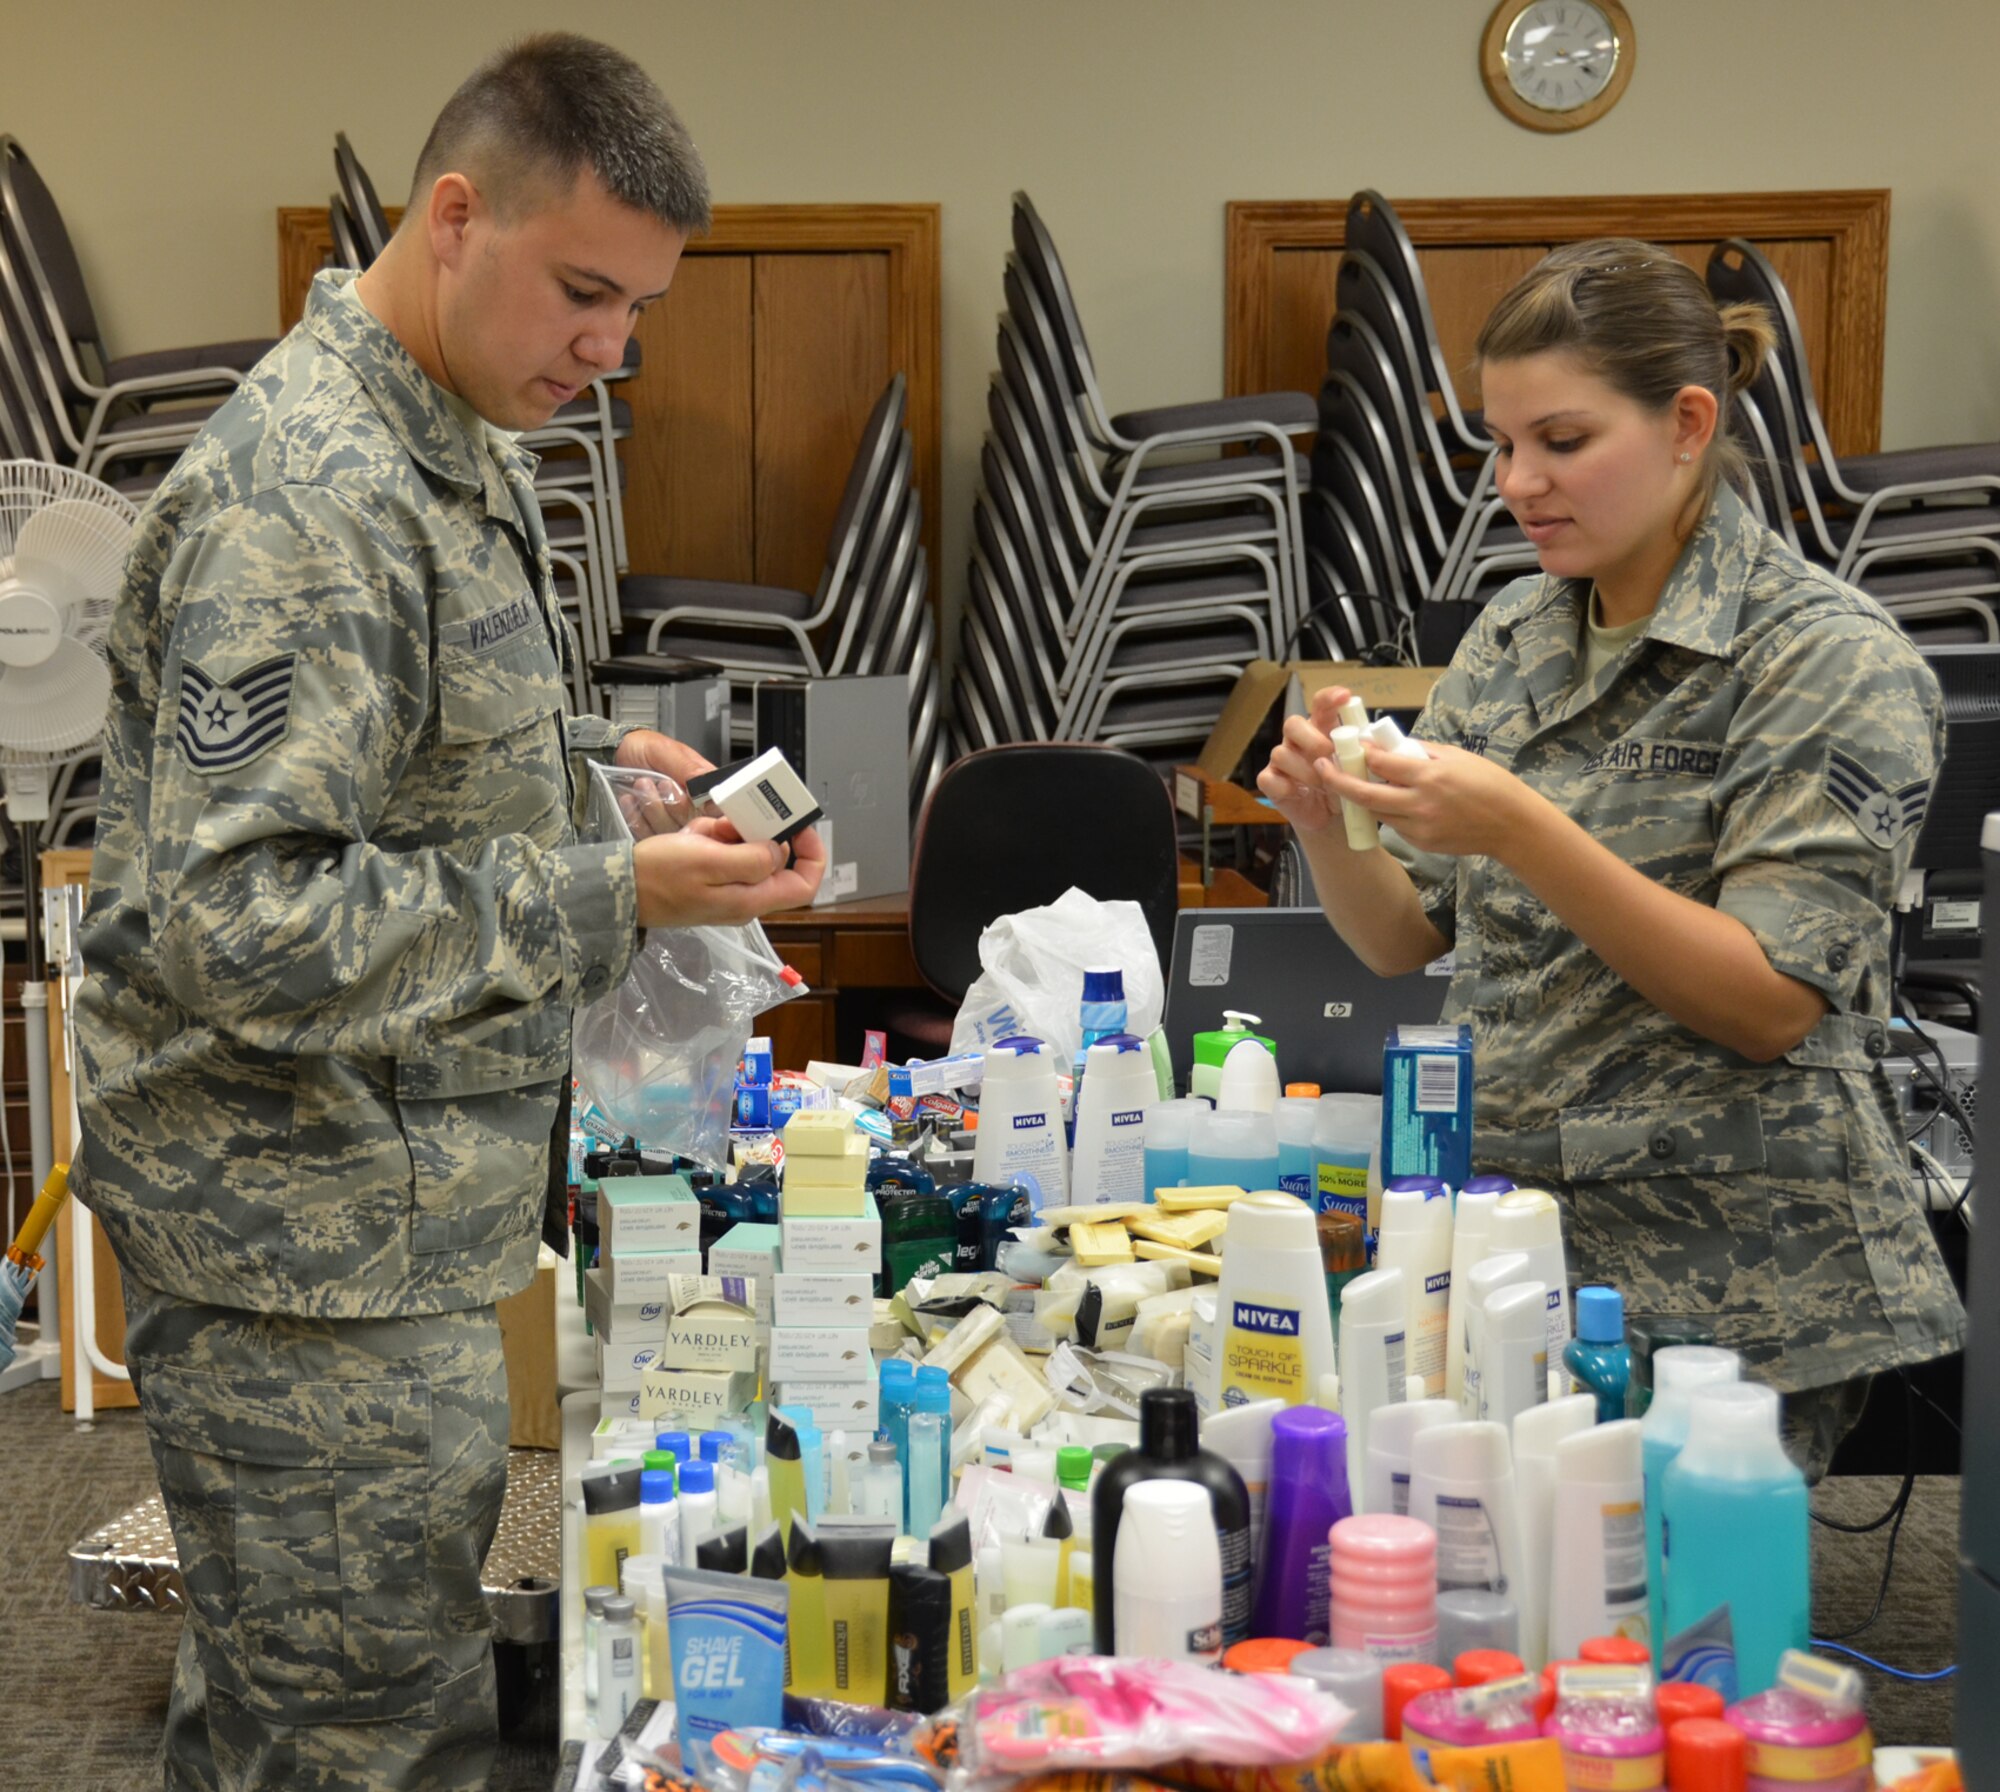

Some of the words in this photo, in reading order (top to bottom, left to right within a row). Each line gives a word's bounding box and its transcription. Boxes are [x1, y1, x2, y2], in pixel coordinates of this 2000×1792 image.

[470, 599, 532, 650] VALENZUELA
[1607, 743, 1642, 768] AIR
[1652, 744, 1722, 776] FORCE
[921, 1096, 958, 1113] Colgate
[1014, 1115, 1045, 1128] NIVEA
[1113, 1112, 1142, 1125] NIVEA
[585, 1119, 621, 1145] Aquafresh
[1280, 1176, 1312, 1194] Suave
[1319, 1174, 1337, 1186] 50%
[1338, 1177, 1368, 1189] MORE
[875, 1188, 917, 1197] PROTECTED
[1320, 1195, 1365, 1217] Suave
[914, 1263, 940, 1279] Spring
[918, 1259, 936, 1272] Irish
[641, 1304, 661, 1316] Dial
[1237, 1307, 1294, 1331] NIVEA
[671, 1332, 750, 1348] YARDLEY
[1236, 1344, 1274, 1359] TOUCH
[1278, 1352, 1297, 1361] OF
[1228, 1354, 1302, 1378] SPARKLE
[646, 1385, 723, 1405] YARDLEY
[685, 1636, 744, 1655] SHAVE
[835, 1621, 848, 1688] ESTHETIQUE
[681, 1655, 744, 1688] GEL
[894, 1644, 912, 1694] AXE
[687, 1690, 705, 1698] FOR
[709, 1689, 733, 1698] MEN
